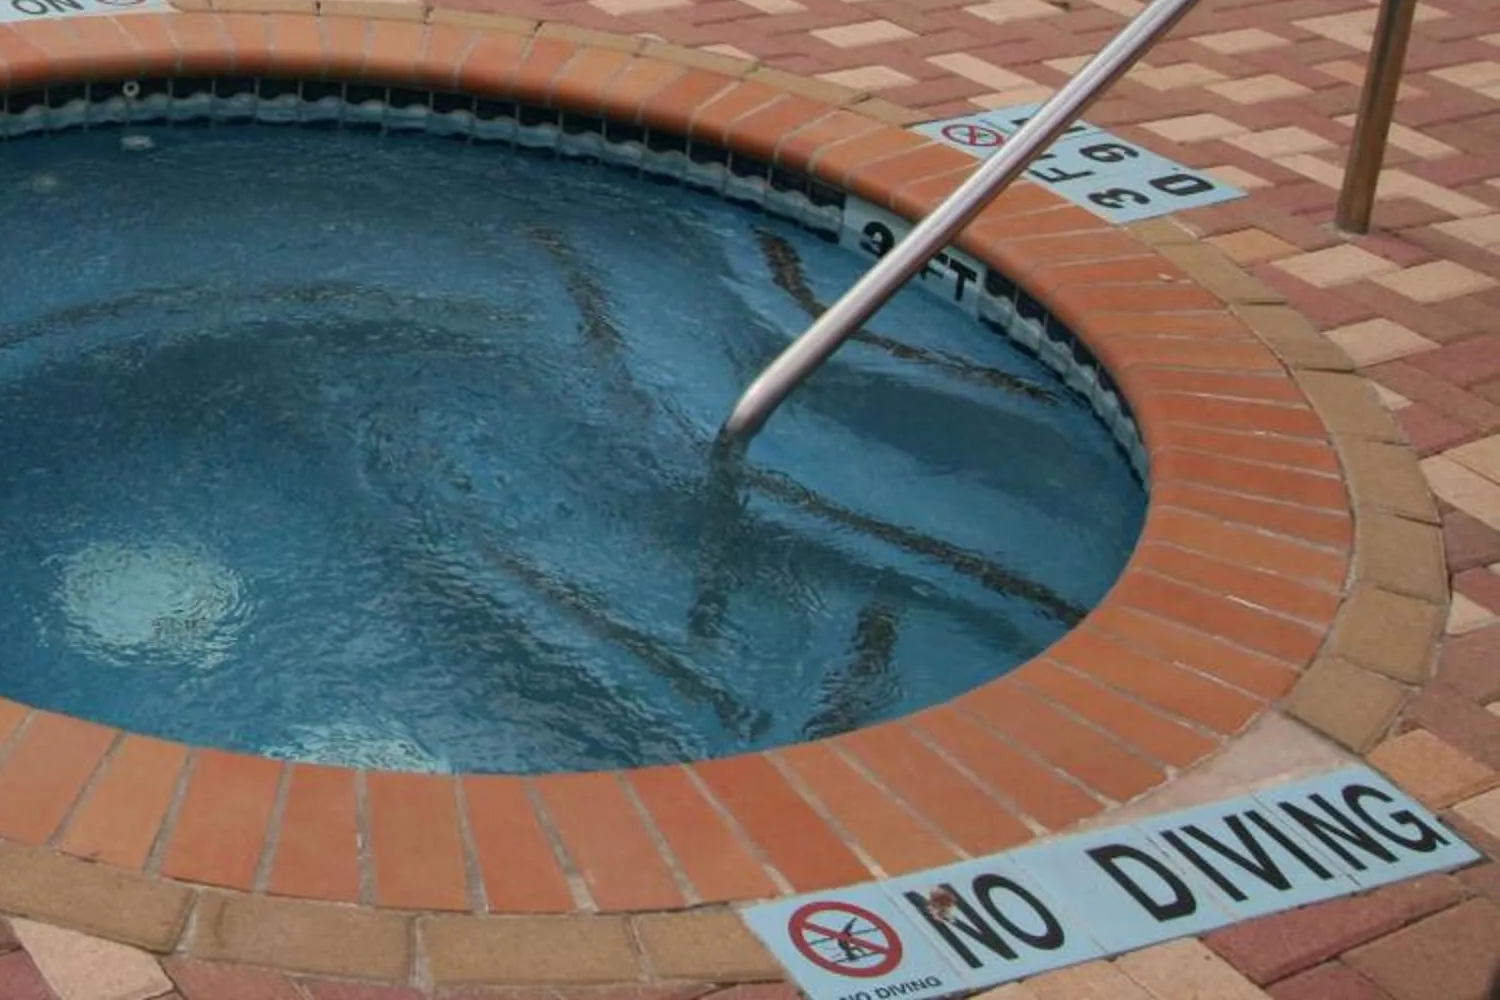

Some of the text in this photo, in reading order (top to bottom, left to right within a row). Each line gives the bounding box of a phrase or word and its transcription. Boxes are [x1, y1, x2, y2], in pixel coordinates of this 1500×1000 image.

[1087, 187, 1151, 209] 3
[903, 783, 1451, 970] NO DIVING
[874, 976, 943, 999] DIVING
